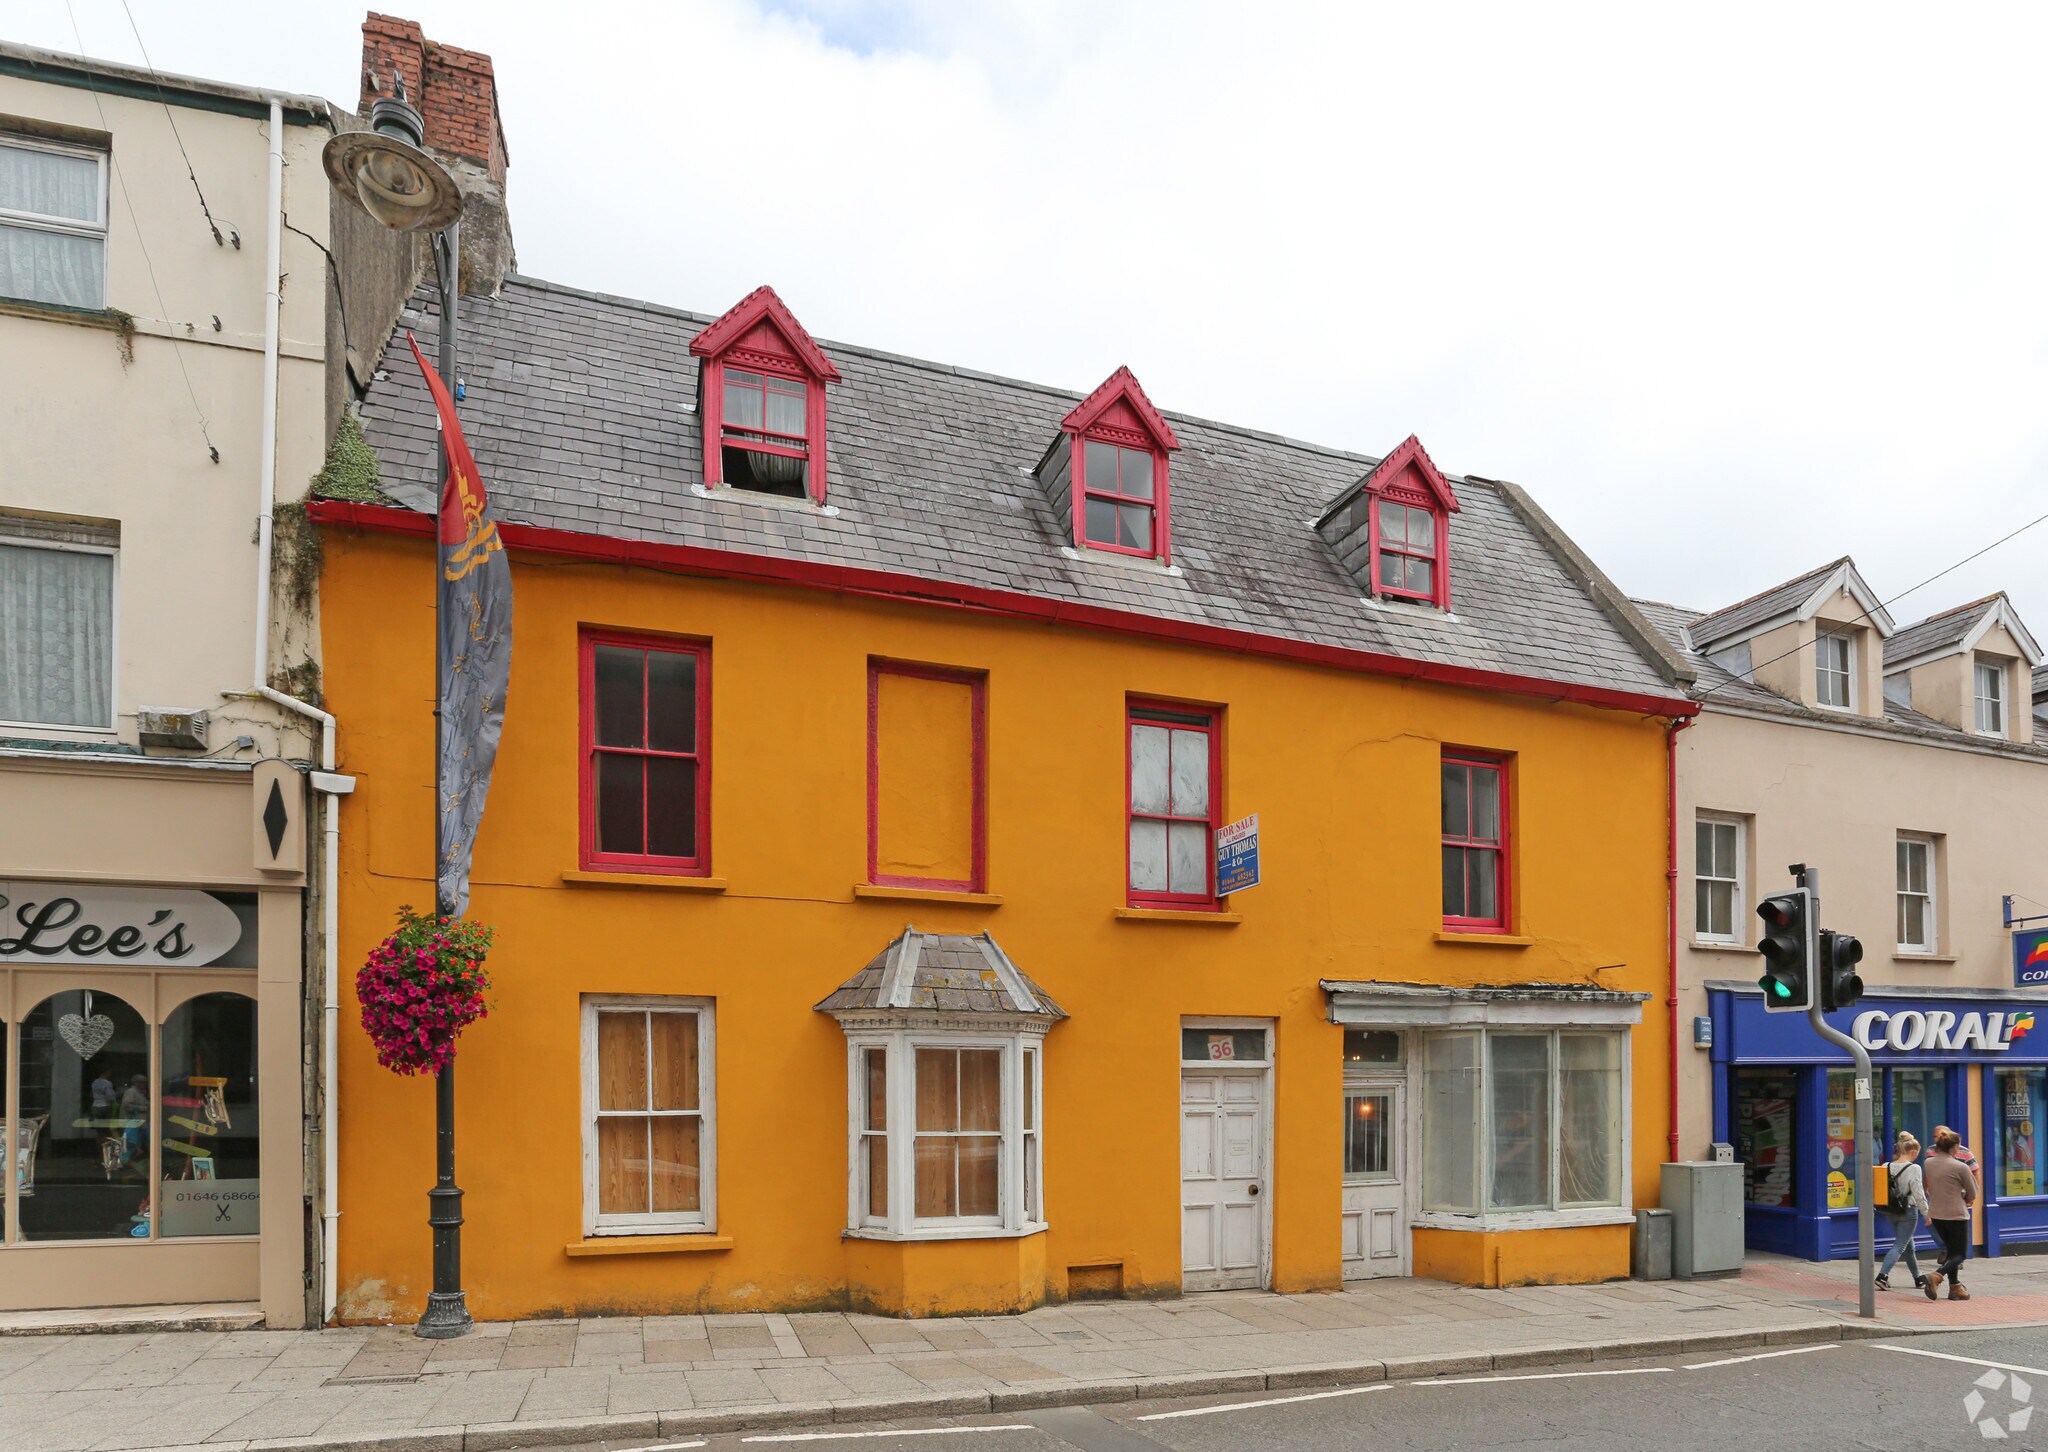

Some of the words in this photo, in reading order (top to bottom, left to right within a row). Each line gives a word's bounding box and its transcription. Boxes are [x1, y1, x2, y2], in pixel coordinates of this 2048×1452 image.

[1219, 826, 1233, 839] FOR
[1236, 816, 1254, 832] SALE
[1218, 847, 1230, 861] GUY
[1232, 836, 1256, 856] THOMAS
[0, 897, 194, 959] Lee's
[1852, 1010, 2010, 1050] CORAL
[1211, 1041, 1232, 1060] 36
[1827, 1088, 1850, 1100] AME
[2006, 1092, 2029, 1105] ACCA
[2007, 1106, 2029, 1116] BOOST
[176, 1192, 219, 1201] 01646
